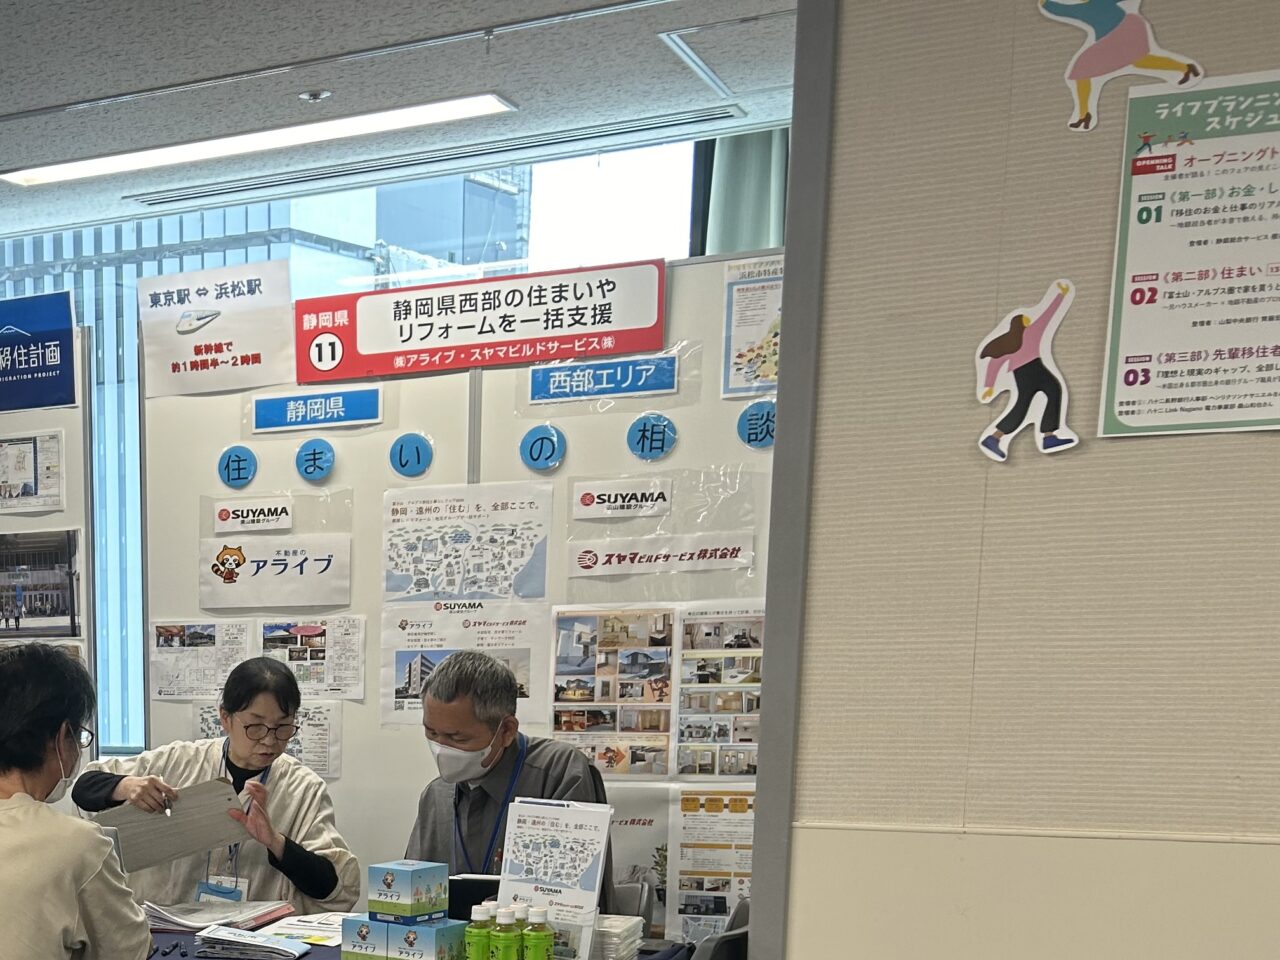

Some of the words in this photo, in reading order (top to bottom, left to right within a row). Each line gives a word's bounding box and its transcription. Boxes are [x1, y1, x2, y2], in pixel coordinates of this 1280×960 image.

[1137, 206, 1163, 224] 01
[148, 288, 191, 309] 東京駅
[214, 278, 263, 299] 浜松駅
[393, 278, 617, 321] 静岡県西部の住まいや
[1130, 287, 1158, 305] 02
[302, 309, 350, 329] 静岡県
[399, 303, 613, 343] リフォームを一括支援
[193, 341, 234, 357] 新幹線で
[315, 341, 336, 362] 11
[34, 370, 61, 379] PROJECT
[548, 365, 656, 396] 西部エリア
[1124, 368, 1151, 386] 03
[286, 397, 346, 422] 静岡県
[596, 491, 668, 505] SUYAMA
[231, 506, 289, 520] SUYAMA
[275, 548, 307, 557] 不動産の
[250, 553, 333, 577] アライブ
[442, 602, 484, 611] SUYAMA
